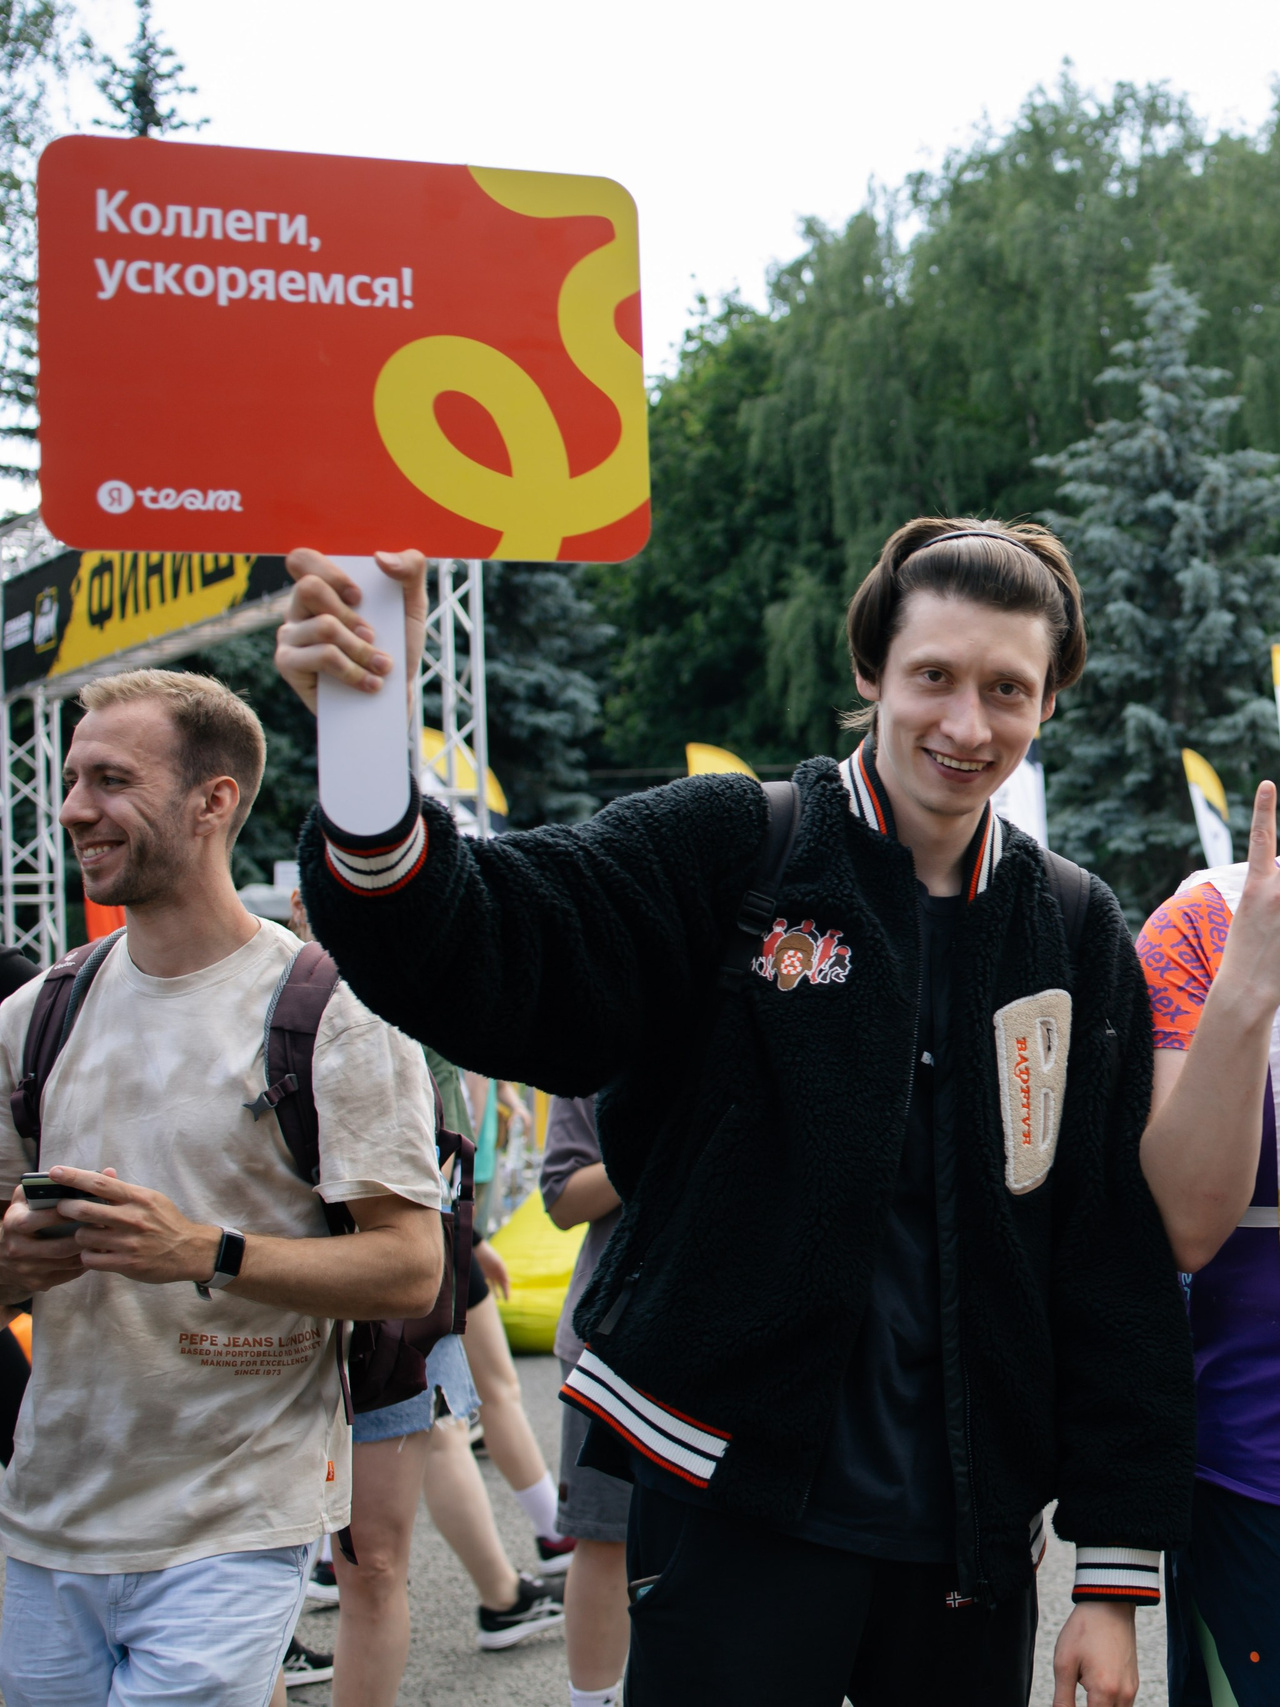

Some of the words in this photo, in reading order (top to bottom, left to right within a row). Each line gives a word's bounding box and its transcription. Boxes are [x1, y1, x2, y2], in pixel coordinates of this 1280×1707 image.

[95, 188, 322, 252] Коллеги,
[94, 258, 415, 310] ускоряемся!
[136, 486, 244, 512] team
[88, 551, 235, 633] ФИНИШ
[178, 1333, 219, 1347] PEPE
[222, 1336, 274, 1348] JEANS
[180, 1347, 212, 1357] BASED
[213, 1349, 223, 1357] IN
[225, 1350, 284, 1358] PORTOBELLO
[294, 1340, 321, 1355] MARKET
[200, 1358, 238, 1367] MAKING
[239, 1359, 258, 1367] FOR
[259, 1355, 309, 1367] EXCELLENCE
[234, 1368, 261, 1376] SINCE
[262, 1368, 282, 1376] 1973
